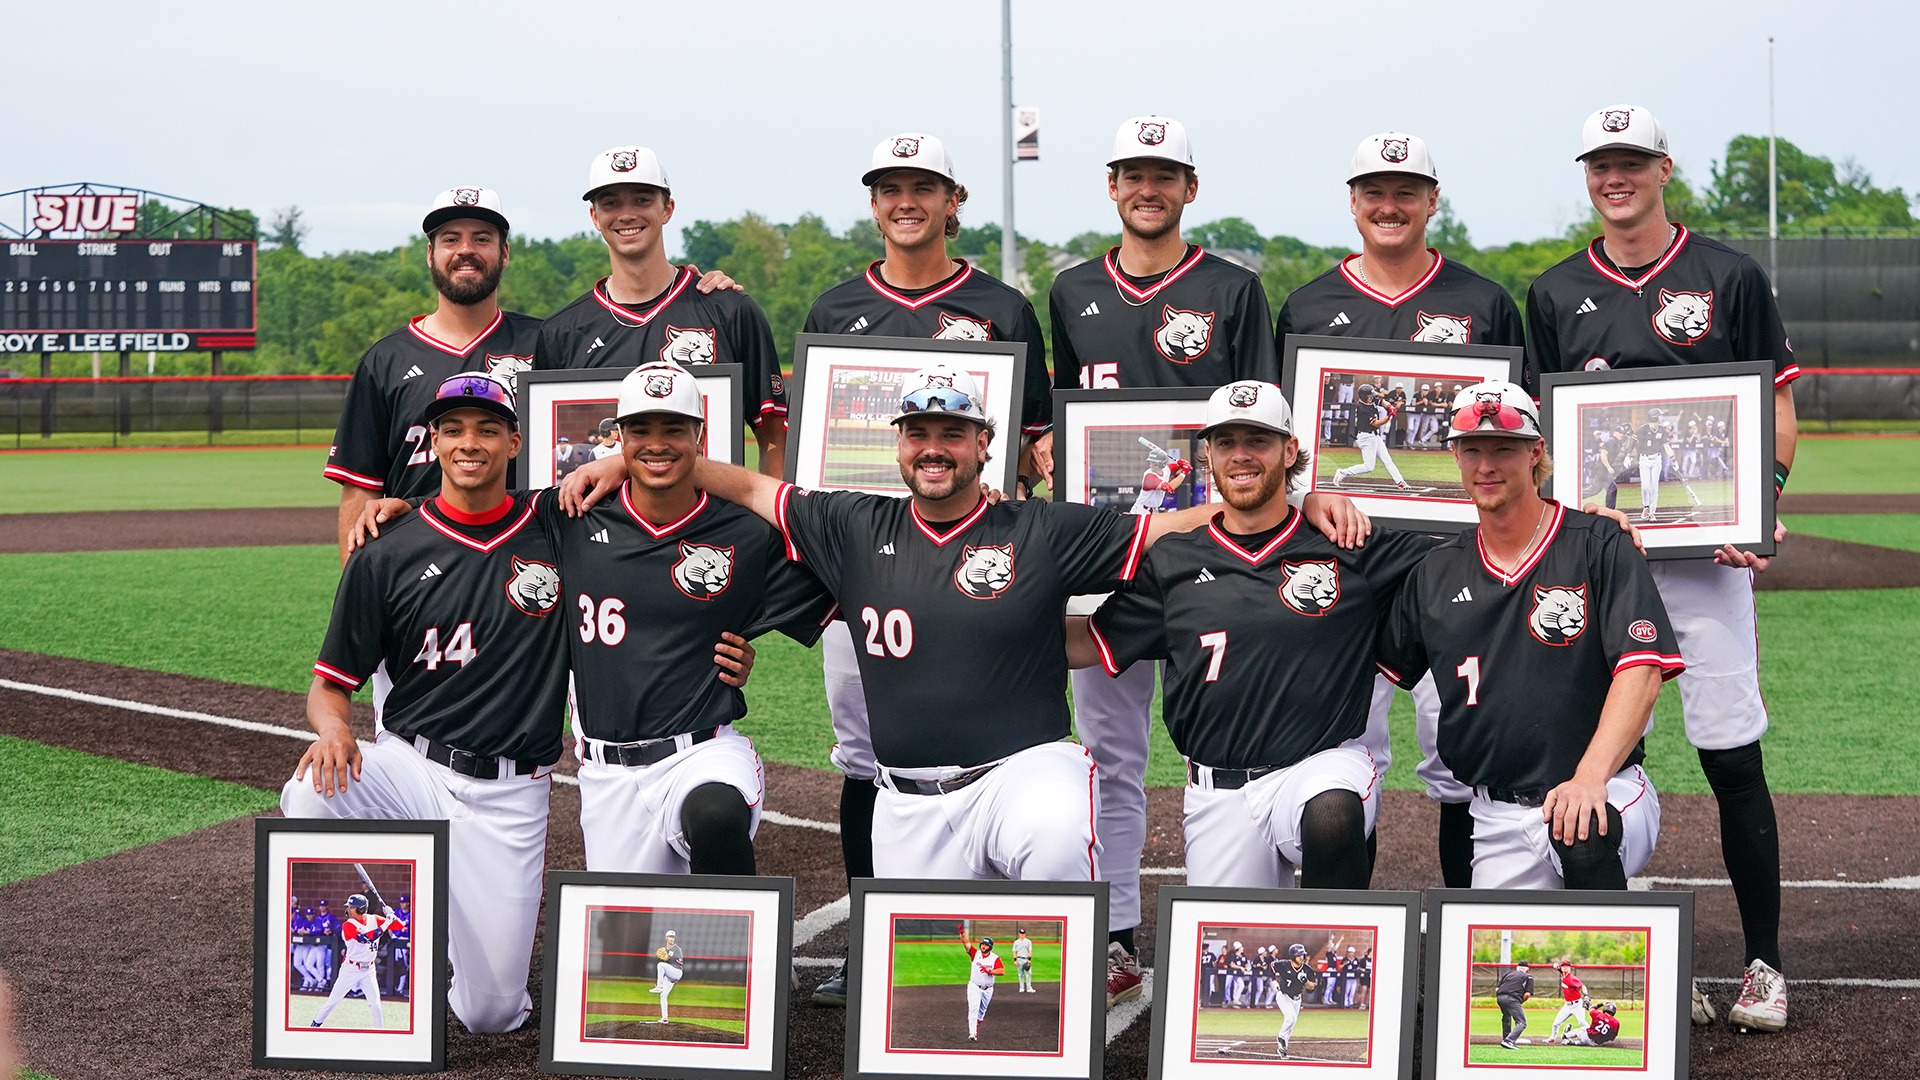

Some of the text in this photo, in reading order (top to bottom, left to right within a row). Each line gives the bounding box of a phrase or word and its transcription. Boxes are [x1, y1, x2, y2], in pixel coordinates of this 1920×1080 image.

[34, 195, 138, 232] SIUE
[9, 243, 38, 256] BALL
[77, 242, 117, 256] STRIKE
[148, 242, 172, 256] OUT
[5, 281, 251, 293] 2 3 4 5 6 7 8 9 10 RUNS HITS ERR
[42, 333, 66, 352] E.
[69, 333, 116, 352] LEE
[120, 333, 190, 351] FIELD
[578, 594, 626, 646] 36
[861, 605, 914, 659] 20
[1636, 627, 1653, 636] OVC
[413, 622, 477, 670] 44
[1198, 630, 1228, 682] 7
[1456, 655, 1480, 706] 1
[1202, 955, 1211, 964] 27
[1594, 1020, 1611, 1035] 26
